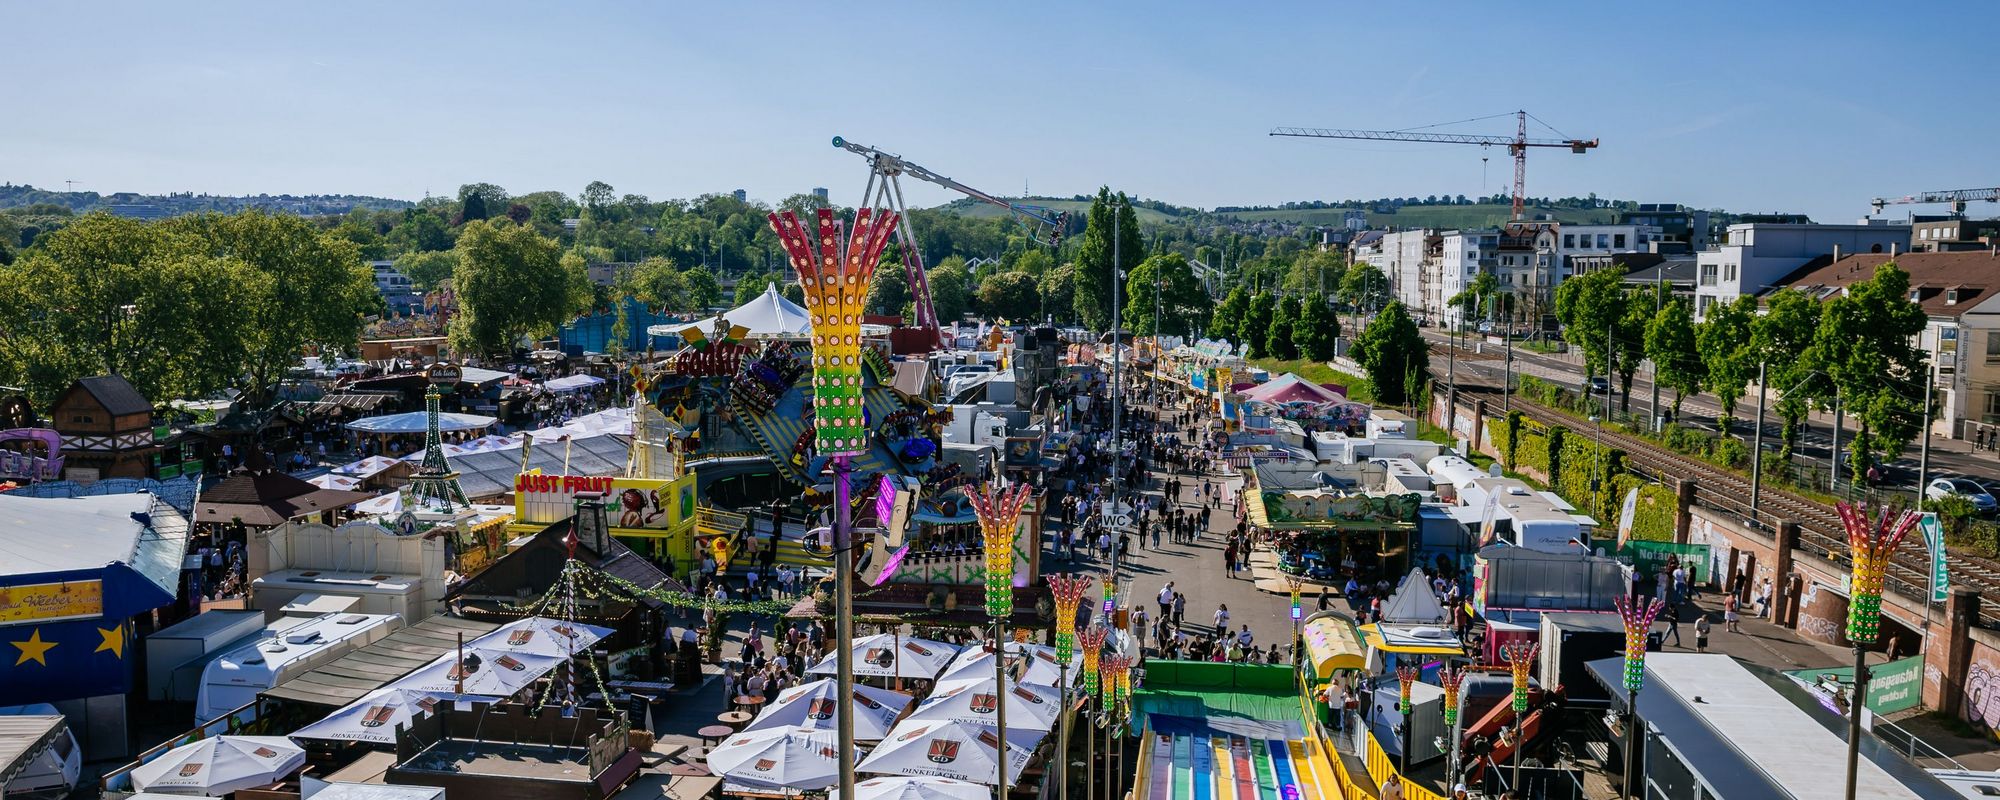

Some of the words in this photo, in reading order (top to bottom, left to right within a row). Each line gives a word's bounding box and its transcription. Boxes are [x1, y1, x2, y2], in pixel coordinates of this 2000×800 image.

[516, 474, 560, 494] JUST
[563, 475, 614, 496] FRUIT
[1103, 515, 1126, 527] WC
[1639, 548, 1704, 565] Notaugang
[330, 732, 391, 742] DINKELACKER
[931, 755, 950, 763] CD
[901, 766, 969, 782] DINKELACKER
